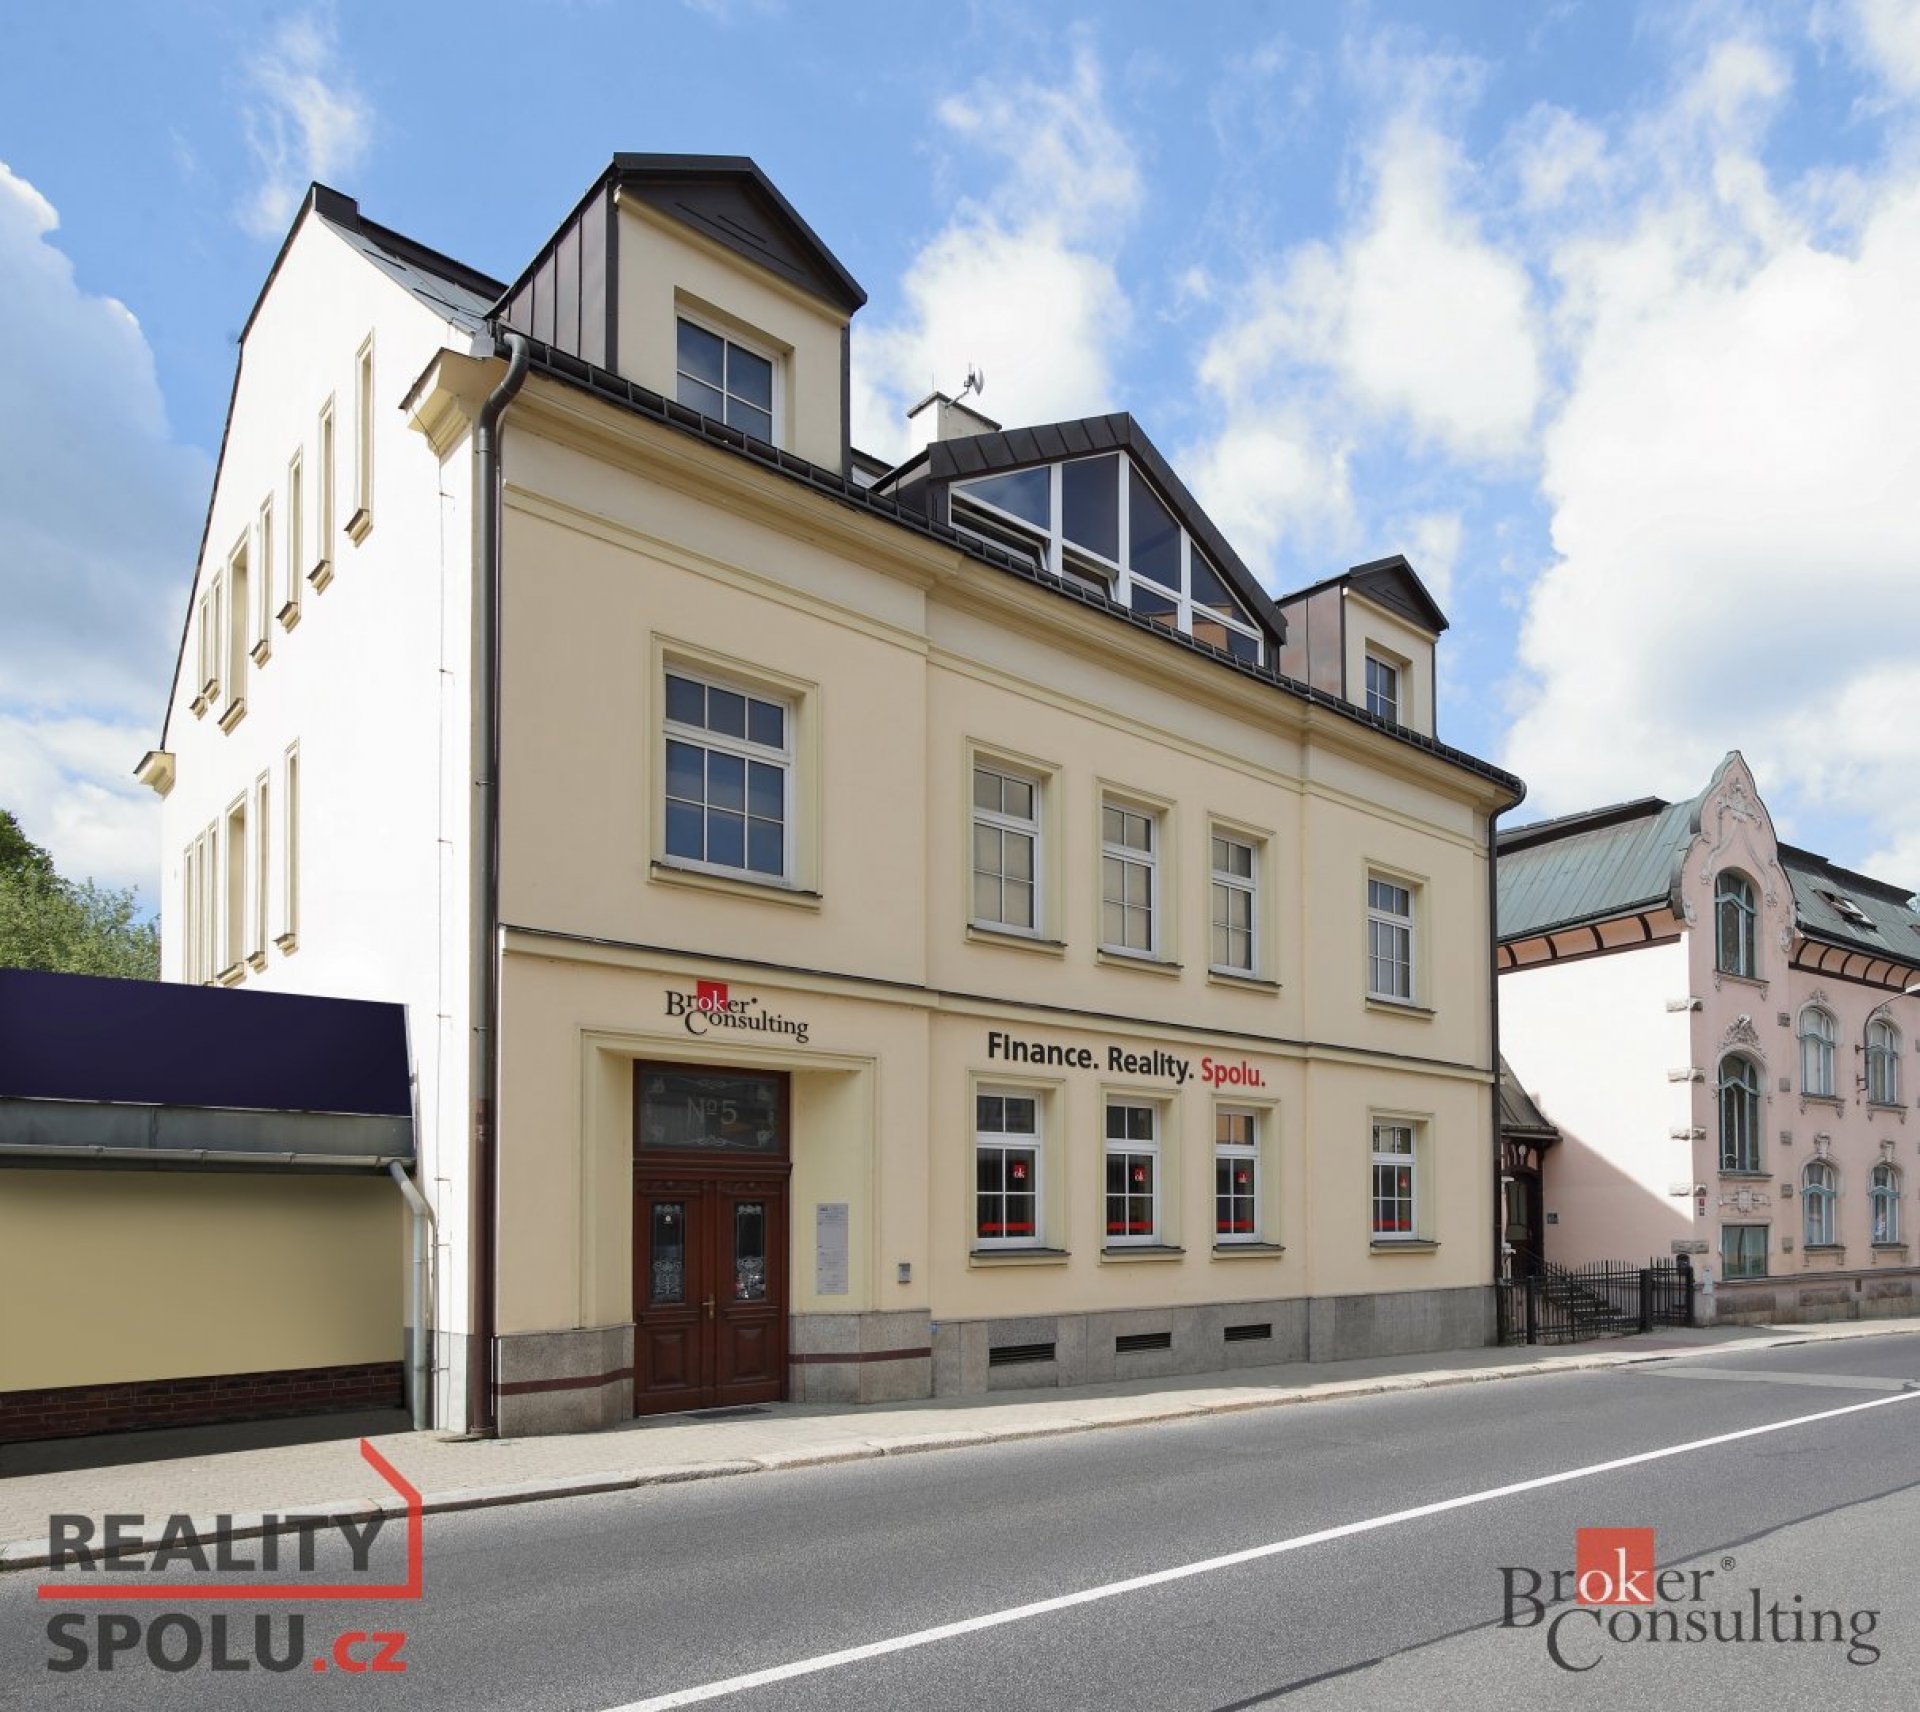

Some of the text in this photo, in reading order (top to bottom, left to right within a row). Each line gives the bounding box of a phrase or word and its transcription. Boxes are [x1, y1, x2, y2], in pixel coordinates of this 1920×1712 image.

[685, 1010, 809, 1043] Consulting
[988, 1031, 1266, 1089] Finance. Reality. Spolu.
